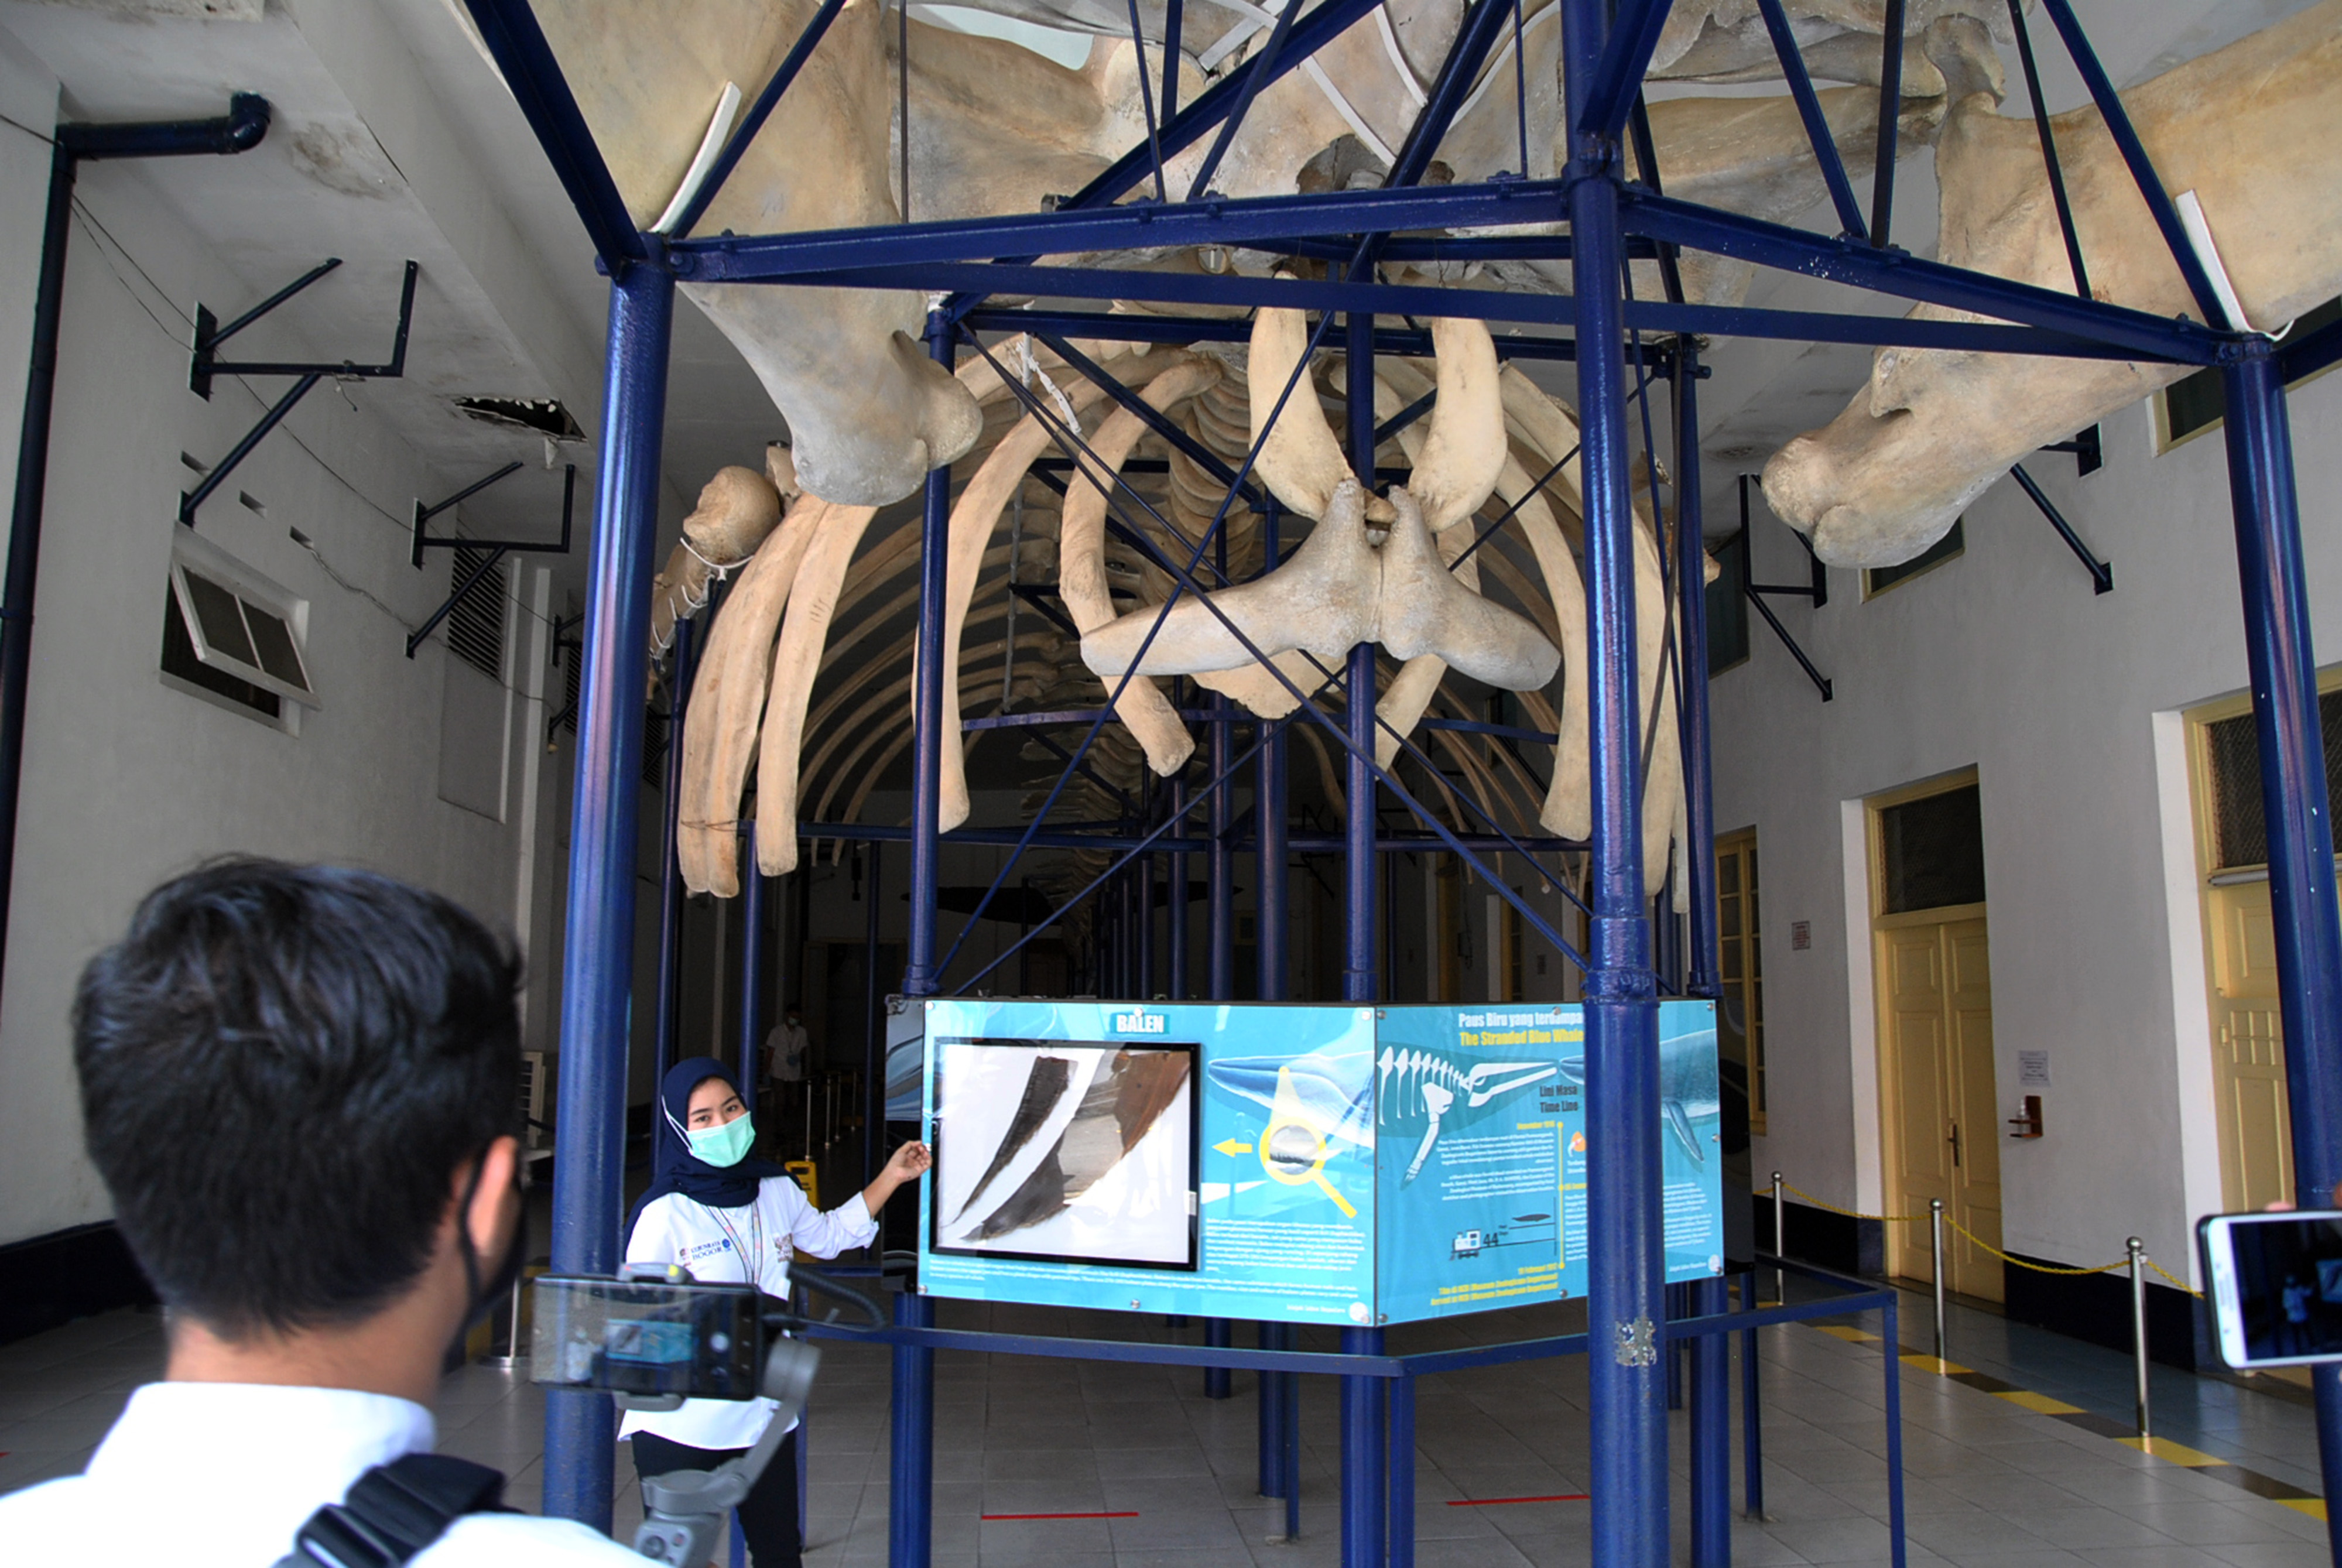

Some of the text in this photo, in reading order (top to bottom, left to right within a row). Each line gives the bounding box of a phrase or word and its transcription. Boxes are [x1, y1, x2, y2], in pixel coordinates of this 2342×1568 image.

[1116, 1014, 1165, 1033] BALEN
[1458, 1012, 1584, 1028] Paus Biru yang terdampa
[1459, 1028, 1585, 1046] The Stranded Blue Whale
[1556, 1084, 1578, 1097] Masa
[1539, 1100, 1579, 1114] Time Line
[1482, 1233, 1499, 1248] 44
[692, 1246, 723, 1261] BOGOR
